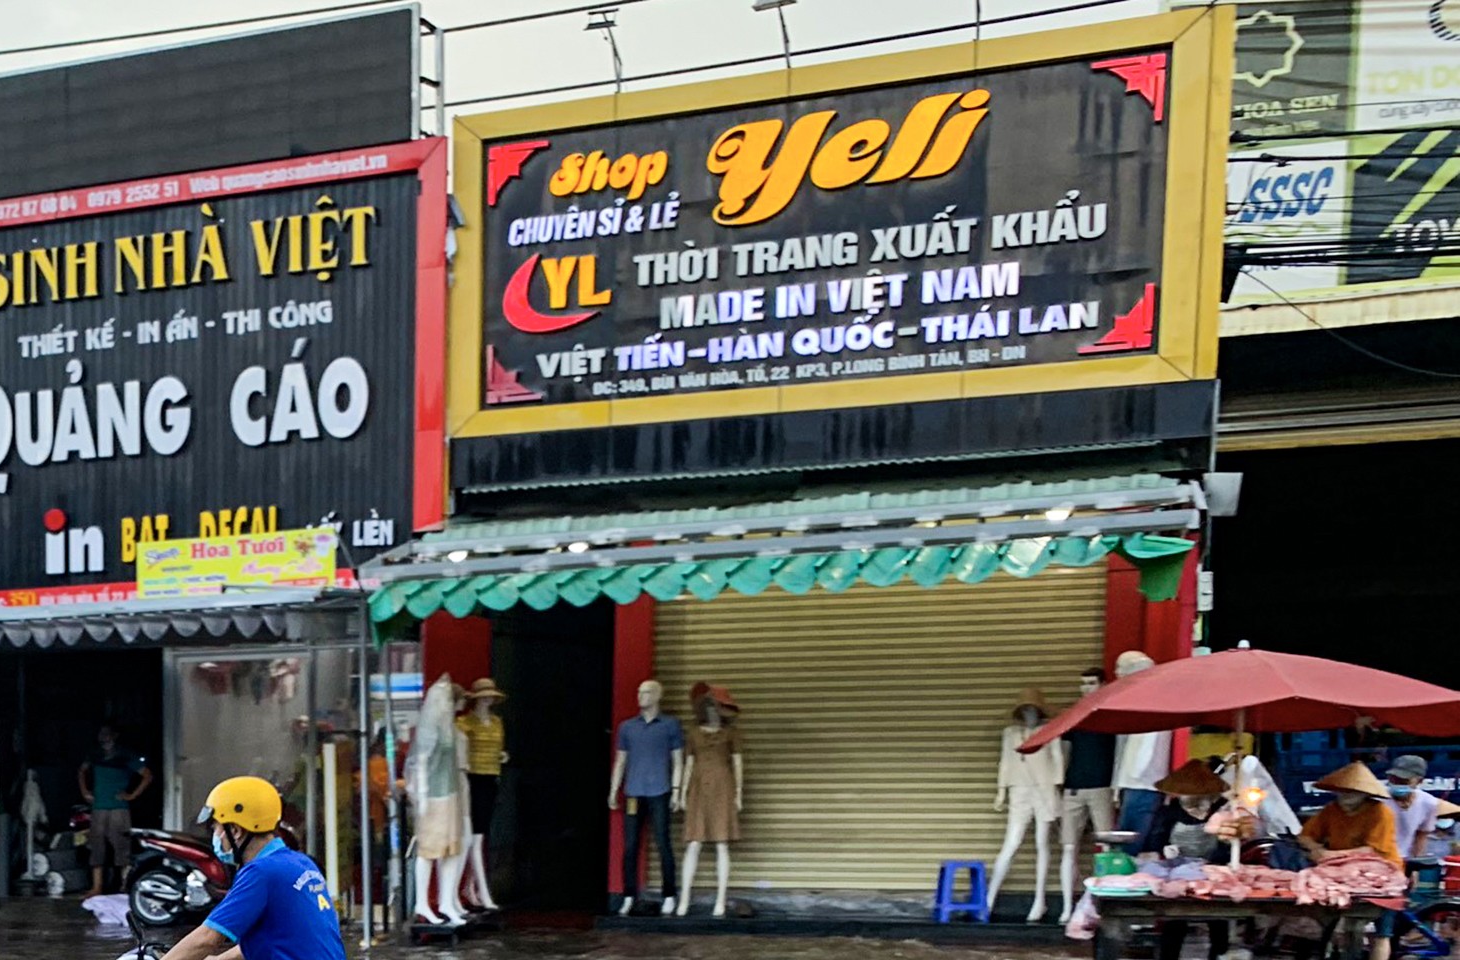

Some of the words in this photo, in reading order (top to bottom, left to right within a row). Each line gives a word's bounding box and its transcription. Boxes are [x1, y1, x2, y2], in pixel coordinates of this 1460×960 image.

[1290, 94, 1339, 115] SEN
[548, 150, 668, 200] Shop
[706, 87, 992, 226] Yeli
[164, 180, 180, 198] 51
[508, 205, 596, 248] CHUYÊN
[597, 197, 626, 236] SỈ
[625, 205, 645, 233] &
[648, 191, 681, 231] LẺ
[114, 202, 230, 294] NHÀ
[251, 194, 378, 284] VIỆT
[633, 240, 719, 287] THỜI
[732, 230, 860, 273] TRANG
[870, 205, 978, 262] XUẤT
[990, 190, 1108, 250] KHẨU
[658, 285, 765, 330] MADE
[775, 281, 816, 318] IN
[826, 268, 909, 316] VIỆT
[921, 262, 1021, 303] NAM
[17, 323, 80, 359] THIẾT
[85, 317, 116, 351] KẾ
[137, 319, 161, 345] IN
[166, 308, 199, 344] ẤN
[222, 308, 262, 336] THI
[269, 299, 333, 330] CÔNG
[536, 343, 607, 383] VIỆT
[1017, 301, 1100, 336] LAN
[229, 336, 370, 448] CÁO
[770, 365, 790, 381] 22
[887, 352, 926, 371] BÌNH
[43, 508, 106, 576] in
[190, 541, 230, 560] Hoa
